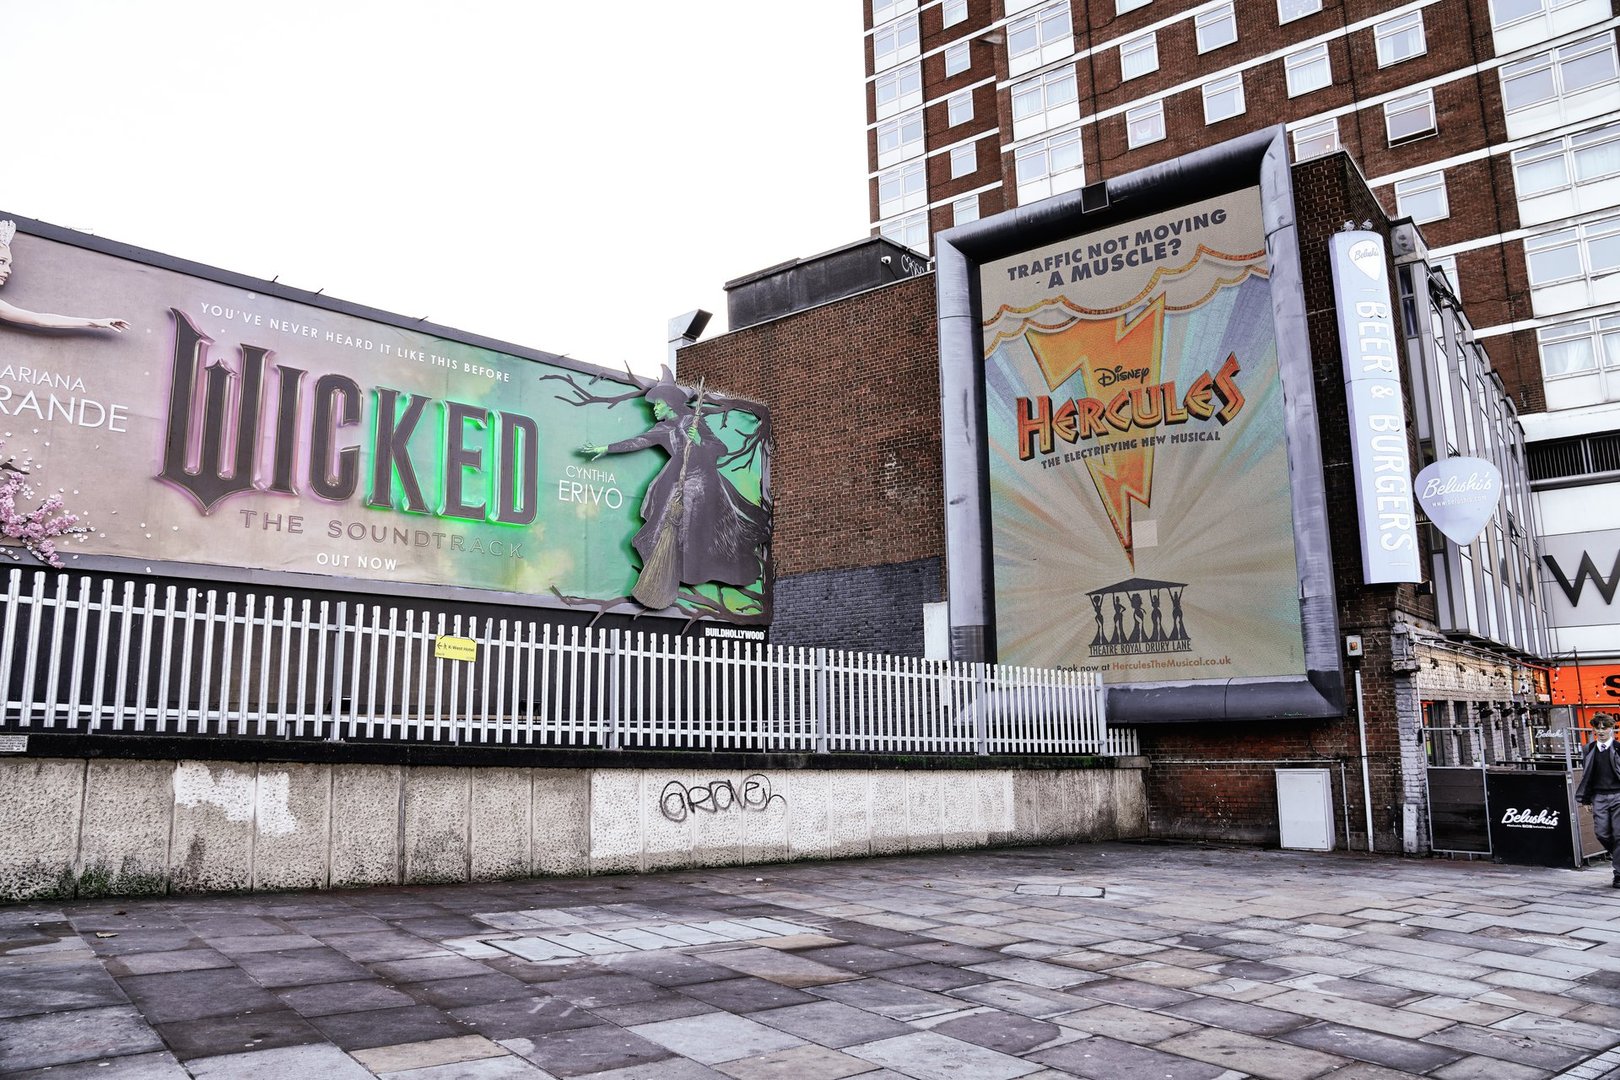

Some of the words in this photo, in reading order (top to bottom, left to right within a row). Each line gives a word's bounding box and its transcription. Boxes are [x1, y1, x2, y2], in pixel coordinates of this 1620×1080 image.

[1007, 248, 1083, 280] TRAFFIC
[1088, 236, 1129, 259] NOT
[1135, 209, 1227, 246] MOVING
[1048, 271, 1064, 288] A
[1071, 238, 1182, 283] MUSCLE?
[201, 302, 262, 326] YOU'VE
[270, 318, 318, 338] NEVER
[326, 331, 373, 350] HEARD
[380, 343, 391, 354] IT
[397, 347, 425, 362] LIKE
[431, 355, 457, 369] THIS
[464, 363, 510, 382] BEFORE
[1355, 301, 1393, 373] BEER
[0, 364, 86, 393] ARIANA
[1370, 384, 1394, 399] &
[153, 306, 539, 526] WICKED
[1016, 352, 1246, 461] HERCULES
[1041, 457, 1060, 469] THE
[1064, 439, 1137, 463] ELECTRIFYING
[1141, 435, 1166, 448] NEW
[1170, 431, 1221, 444] MUSICAL
[566, 465, 616, 484] CYNTHIA
[1369, 414, 1413, 551] BURGERS
[1422, 472, 1492, 499] Belushi's
[559, 479, 623, 509] ERIVO
[240, 509, 304, 534] THE
[327, 519, 524, 558] SOUNDTRACK
[316, 552, 350, 567] OUT
[358, 556, 397, 571] NOW
[705, 627, 765, 640] BUILDHOLLYWOOD
[1089, 644, 1118, 655] THEATRE
[1121, 642, 1143, 653] ROYAL
[1145, 641, 1169, 652] DRURY
[1172, 640, 1191, 651] LANE
[1112, 656, 1232, 670] HerculesTheMusical.co.uk
[1501, 807, 1559, 826] Belushi's
